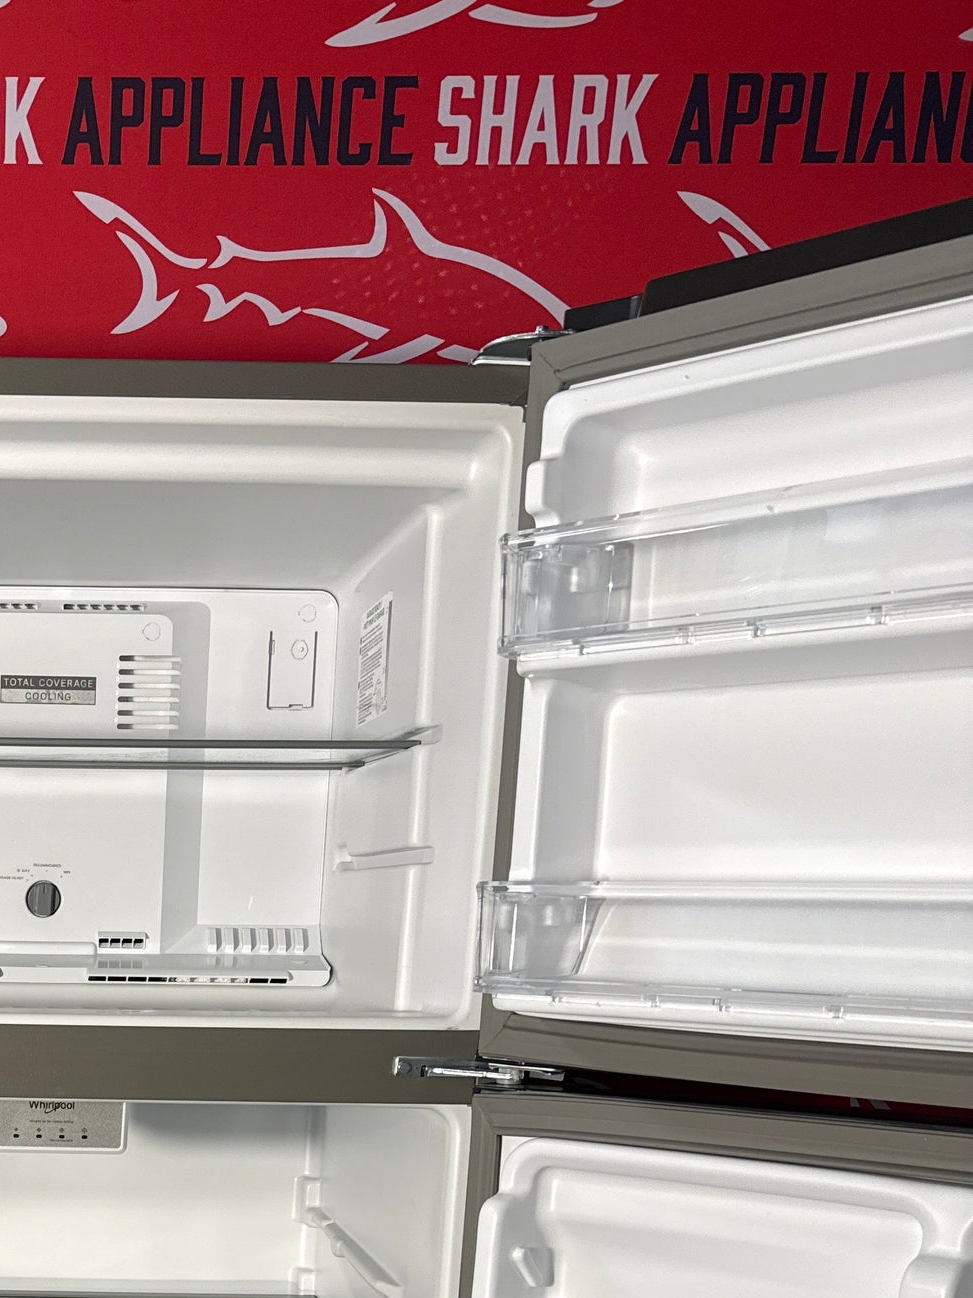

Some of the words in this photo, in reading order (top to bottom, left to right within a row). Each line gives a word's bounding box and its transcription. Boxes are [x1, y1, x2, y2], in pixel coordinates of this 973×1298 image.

[61, 75, 419, 166] APPLIANCE
[434, 74, 658, 165] SHARK
[3, 678, 35, 687] TOTAL
[38, 678, 94, 688] COVERAGE
[24, 691, 72, 701] COOLING
[29, 1100, 75, 1113] Whirlpool
